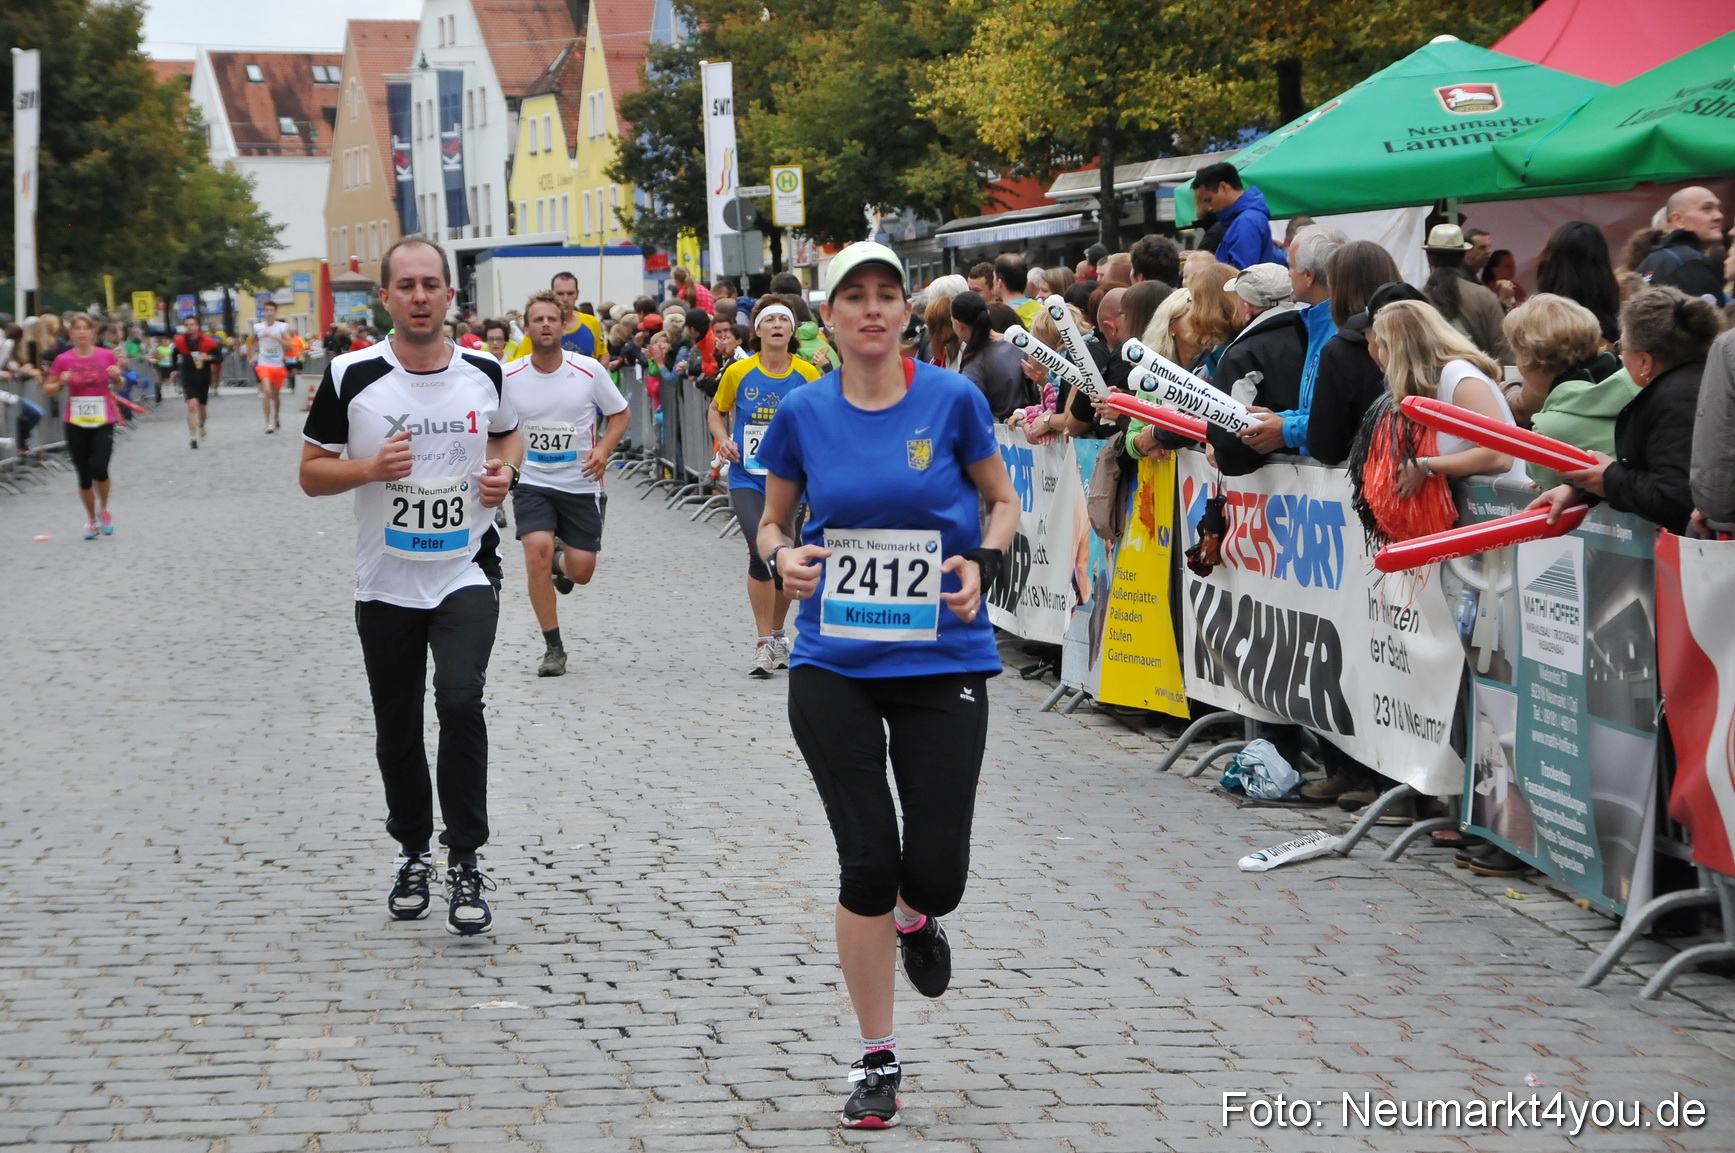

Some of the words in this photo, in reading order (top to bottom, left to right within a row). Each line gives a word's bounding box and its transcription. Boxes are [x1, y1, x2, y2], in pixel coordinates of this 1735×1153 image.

[1031, 346, 1065, 372] BMW
[1164, 384, 1204, 412] BMW
[77, 404, 97, 415] 121
[529, 432, 573, 450] 2347
[385, 482, 415, 494] PARTL
[418, 485, 458, 496] Neumarkt
[392, 496, 464, 529] 2193
[412, 537, 444, 549] Peter
[827, 539, 864, 549] PARTL
[867, 540, 920, 552] Neumarkt
[836, 555, 930, 598] 2412
[846, 606, 911, 625] Krisztina
[1109, 627, 1132, 643] Stufen
